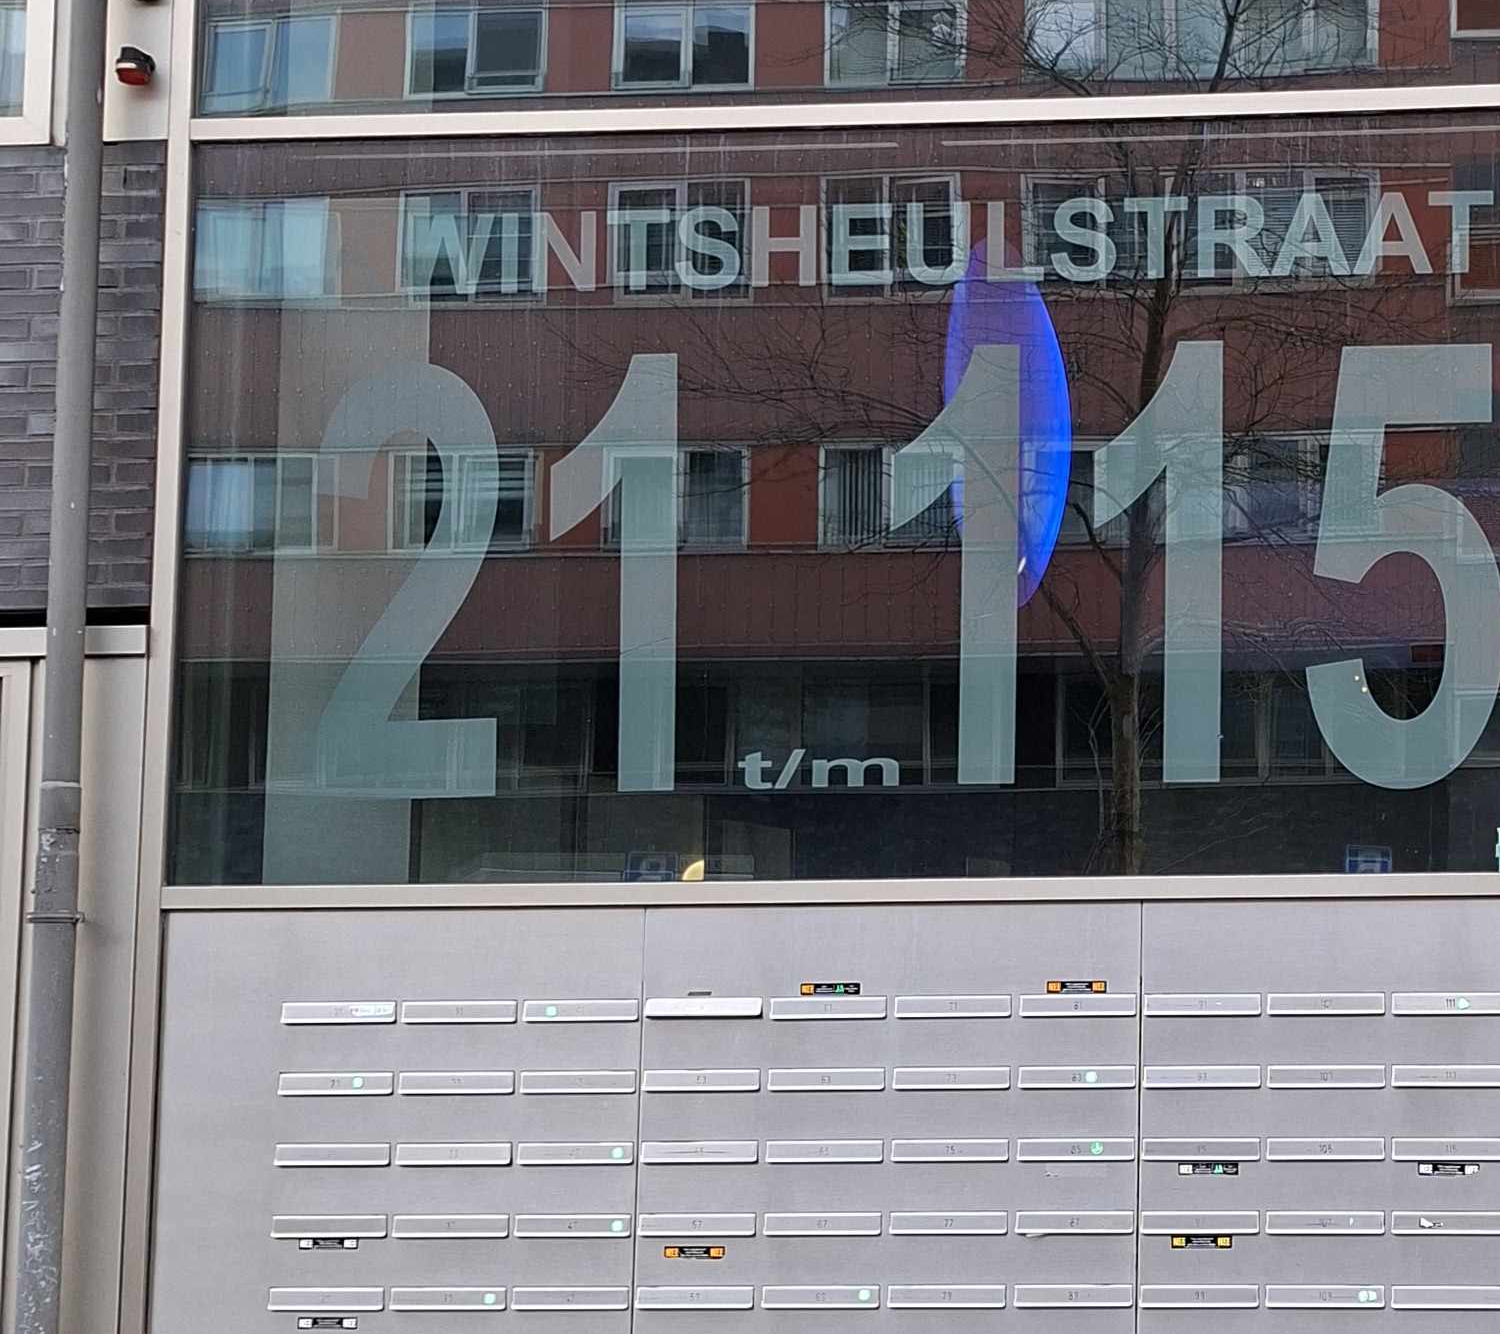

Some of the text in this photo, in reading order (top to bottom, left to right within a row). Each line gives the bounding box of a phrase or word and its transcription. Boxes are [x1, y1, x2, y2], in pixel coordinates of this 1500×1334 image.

[406, 189, 1495, 296] WINTSHEULSTRAAT
[317, 351, 680, 800] 21
[737, 748, 900, 790] t/m
